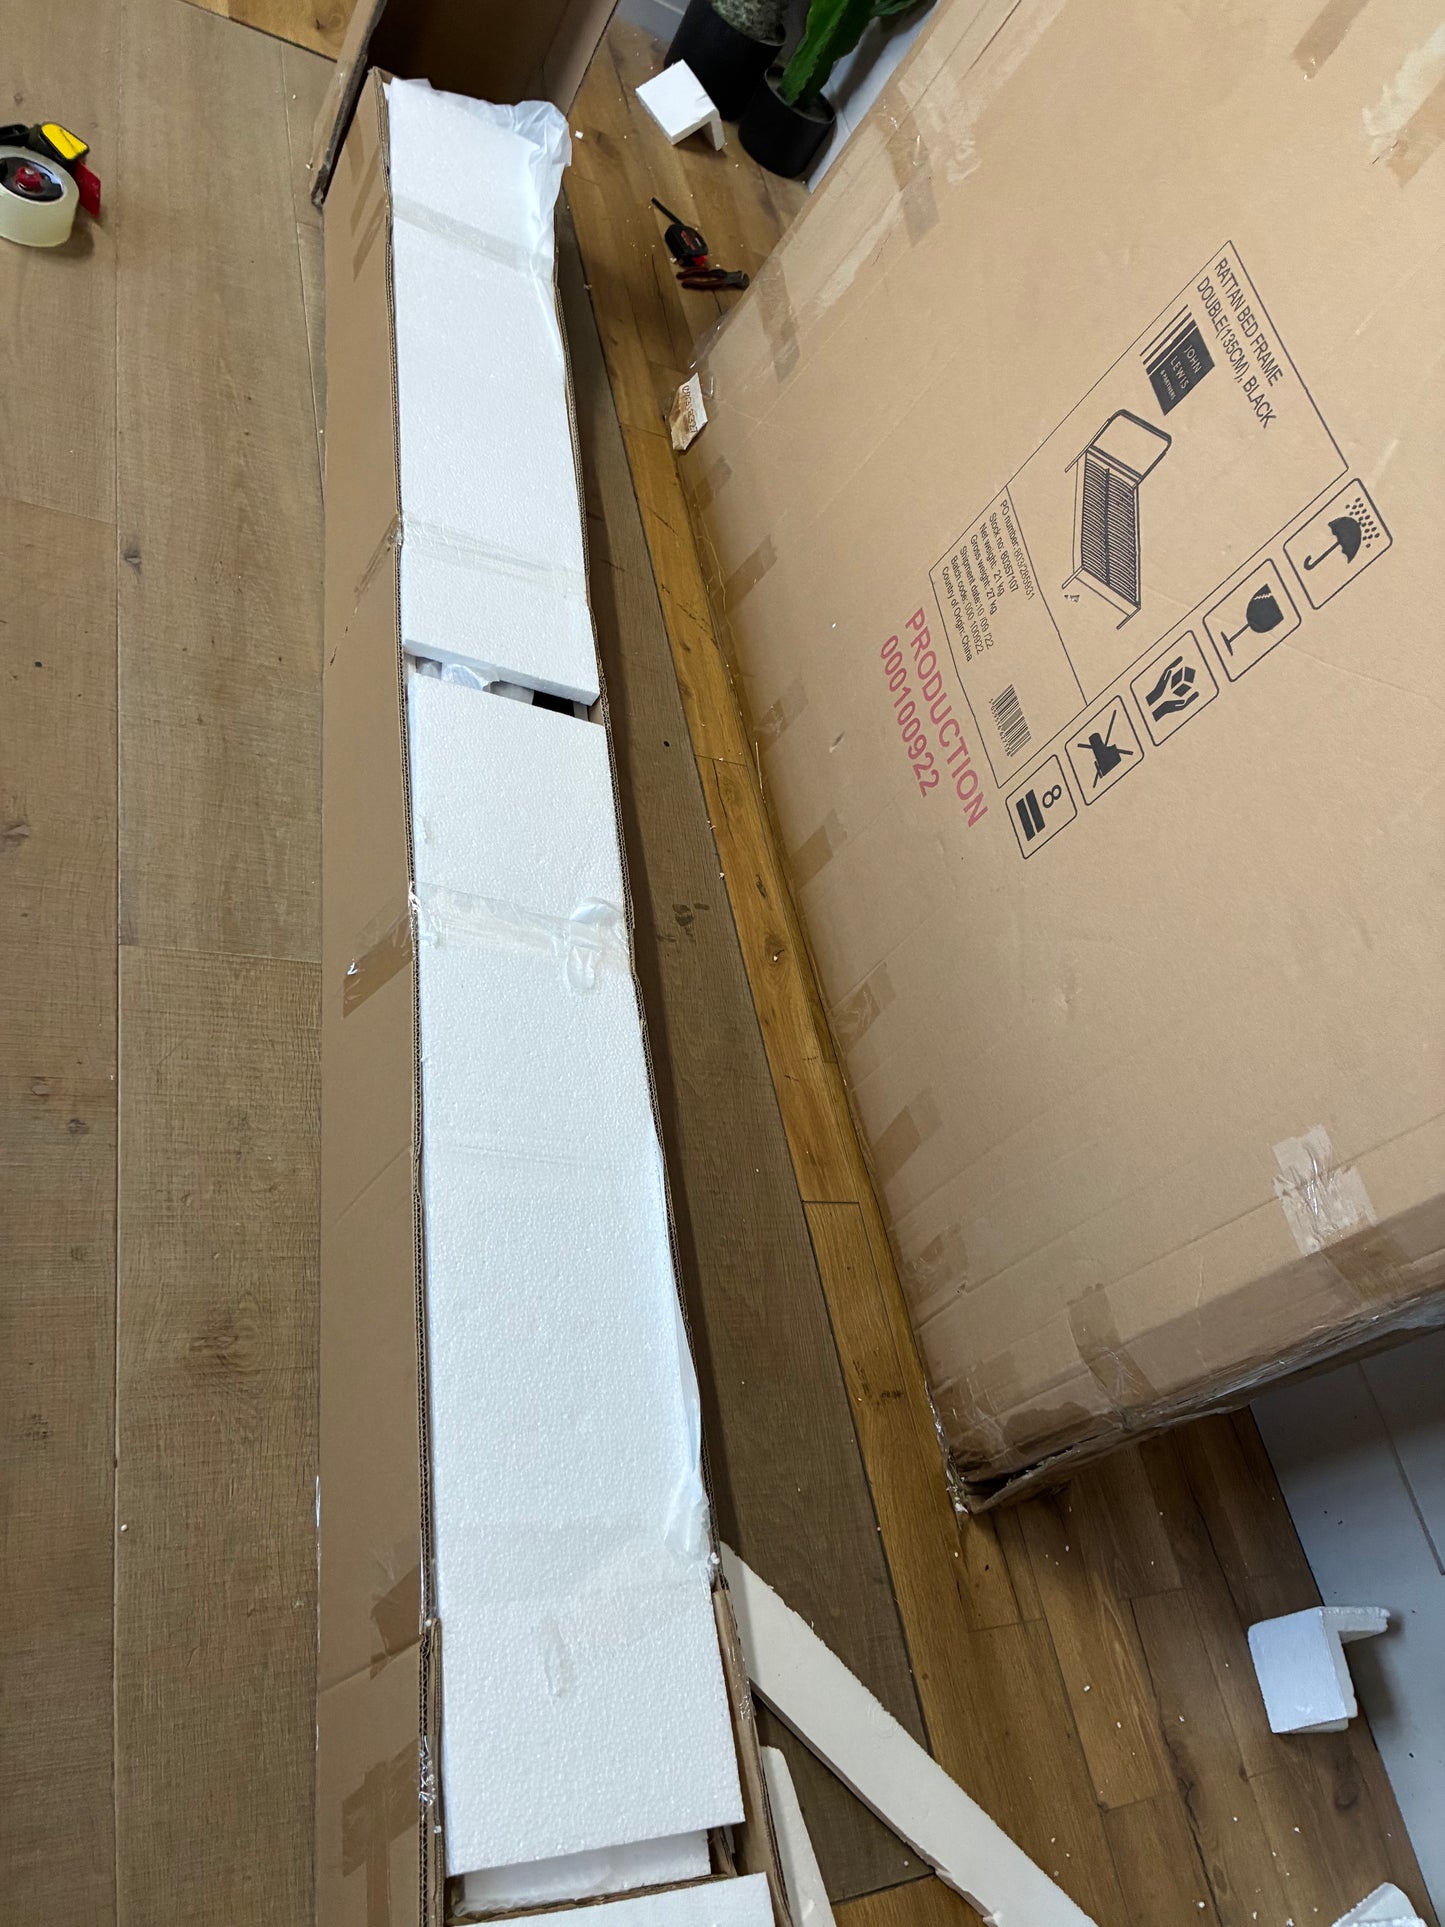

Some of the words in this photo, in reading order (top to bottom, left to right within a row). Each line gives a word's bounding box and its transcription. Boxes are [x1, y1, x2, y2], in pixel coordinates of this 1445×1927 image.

[1214, 257, 1246, 312] RATTAN
[1236, 305, 1259, 338] BED
[1250, 333, 1284, 387] FRAME
[1184, 345, 1202, 374] JOHN
[1196, 276, 1250, 384] DOUBLE(135CM),
[1242, 375, 1277, 429] BLACK
[1170, 355, 1189, 389] LEWIS
[1000, 500, 1010, 516] PO
[980, 522, 989, 541] Net
[989, 512, 1001, 538] Stock
[970, 534, 981, 561] Gross
[983, 539, 997, 570] weight:
[996, 537, 1005, 552] no:
[951, 555, 962, 585] Batch
[958, 580, 968, 604] code:
[960, 545, 975, 586] Shipment
[977, 559, 991, 590] weight:
[993, 570, 1003, 584] 21
[1000, 550, 1019, 593] 80357107
[942, 566, 954, 600] Country
[986, 587, 996, 600] 27
[996, 581, 1005, 597] kg
[951, 599, 959, 609] of
[989, 599, 998, 615] kg
[954, 607, 966, 636] Origin:
[962, 634, 973, 662] China
[880, 634, 940, 799] 000100922
[904, 607, 989, 828] PRODUCTION
[1042, 784, 1062, 808] 8
